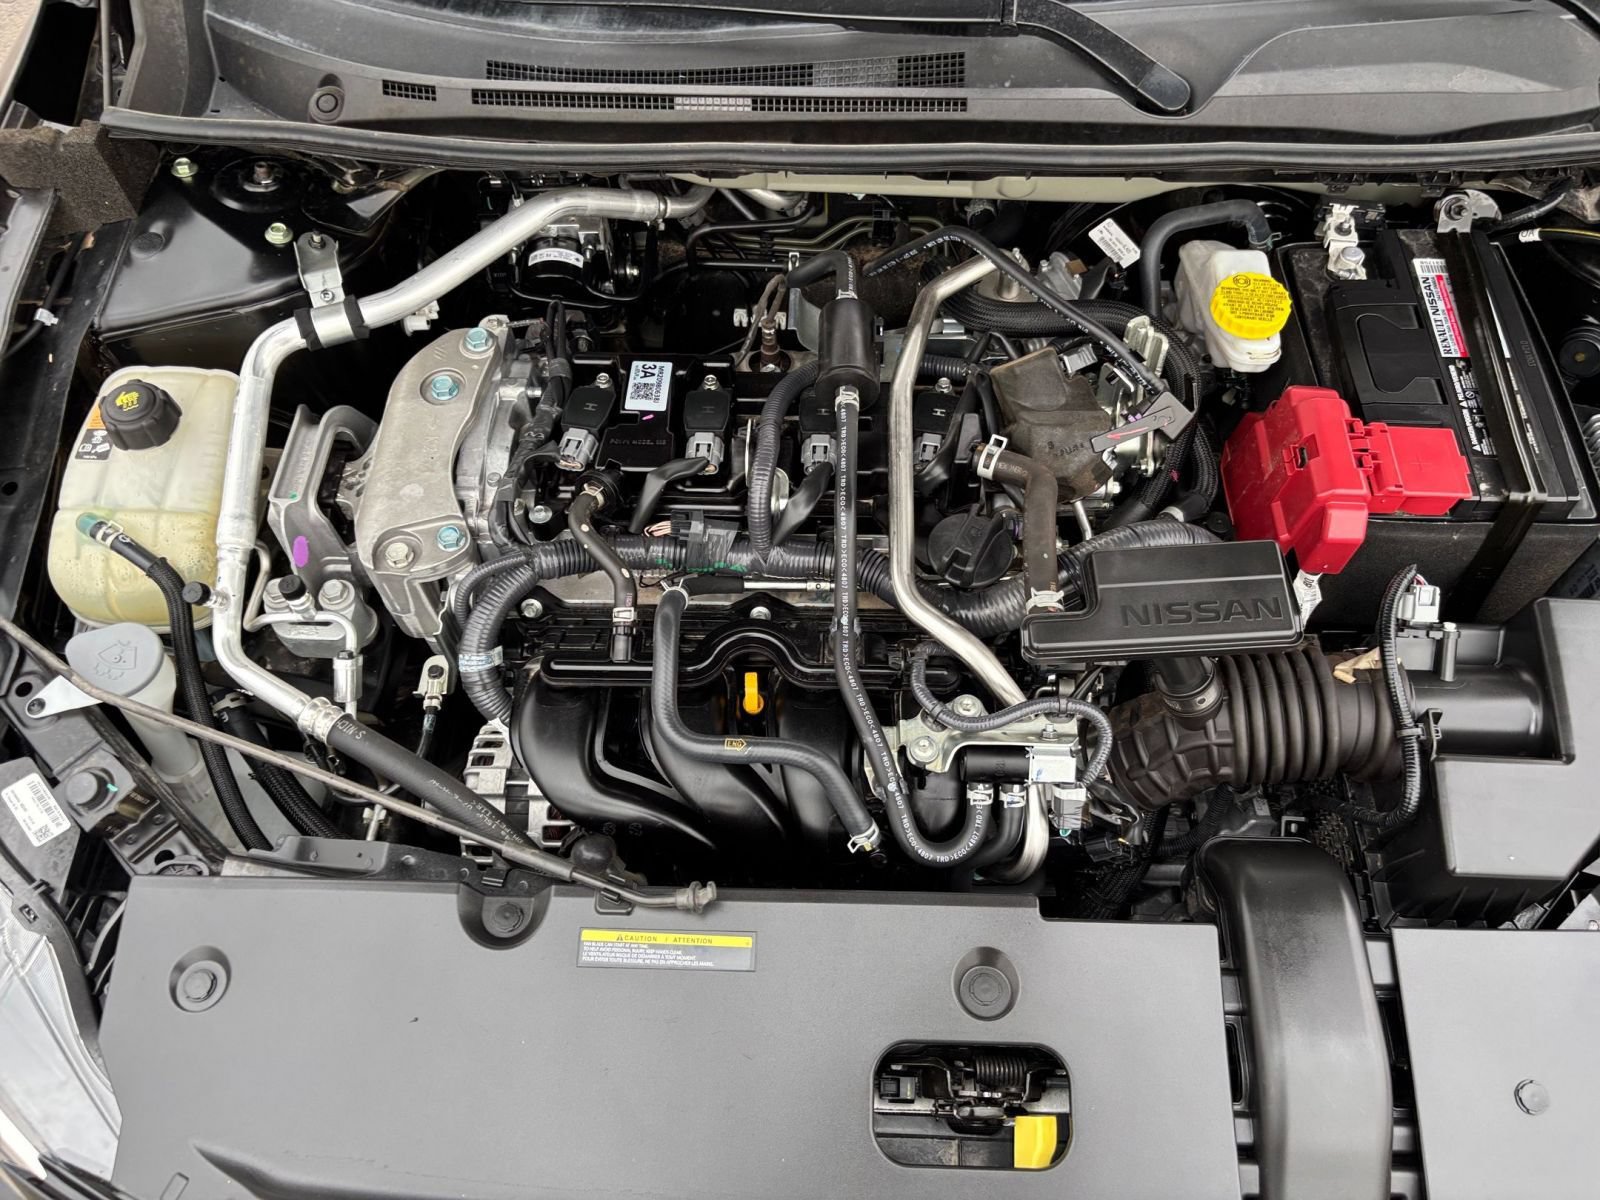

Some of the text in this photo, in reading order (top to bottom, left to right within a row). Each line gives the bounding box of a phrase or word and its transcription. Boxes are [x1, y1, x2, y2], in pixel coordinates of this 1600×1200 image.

[1421, 276, 1441, 316] NISSAN
[1434, 317, 1452, 355] RENAULT
[640, 363, 657, 379] 3A
[1120, 597, 1283, 627] NISSAN
